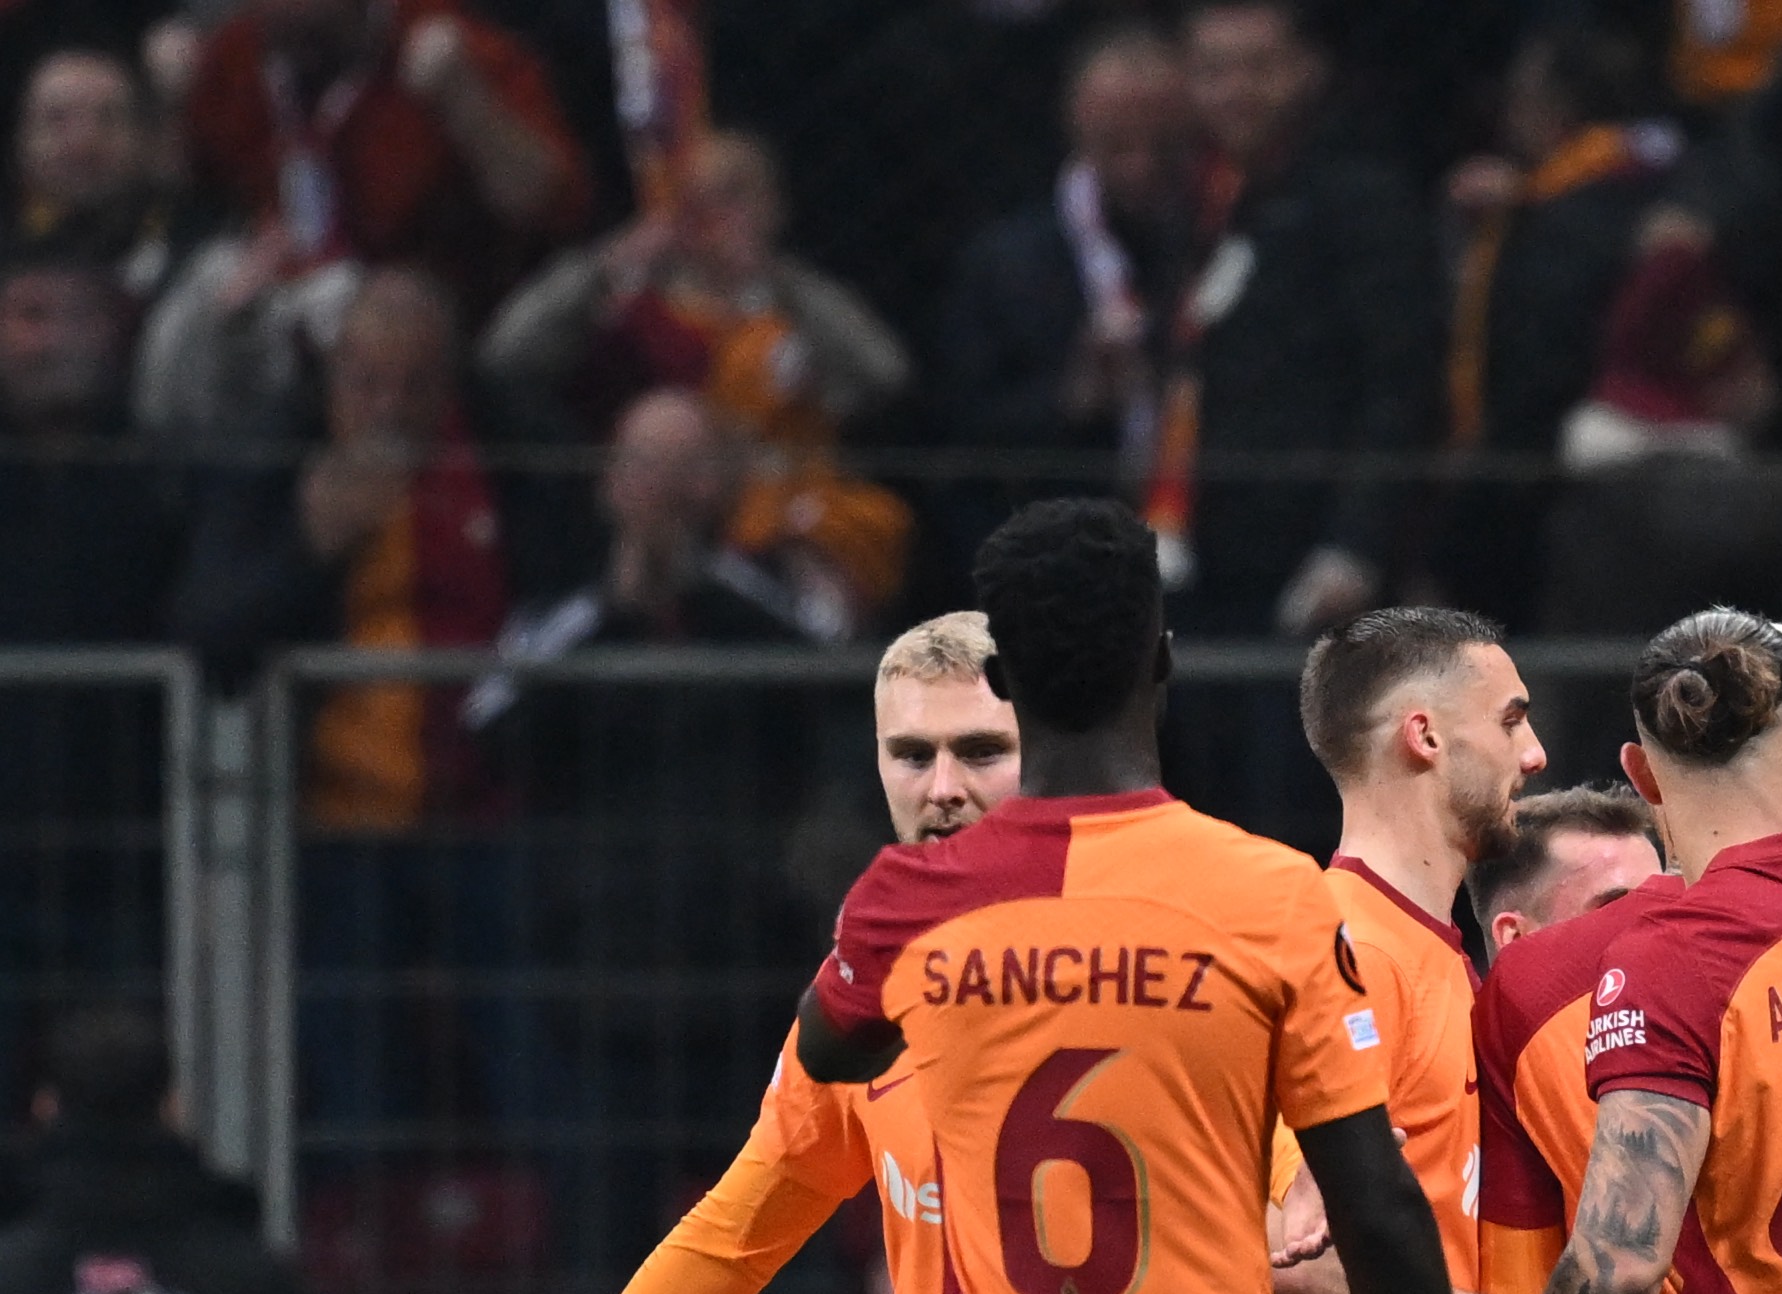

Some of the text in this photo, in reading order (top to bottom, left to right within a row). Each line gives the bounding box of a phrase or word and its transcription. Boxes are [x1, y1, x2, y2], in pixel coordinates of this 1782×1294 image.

[922, 947, 1213, 1012] SANCHEZ
[1586, 1009, 1645, 1039] URKISH
[1584, 1027, 1647, 1066] AIRLINES
